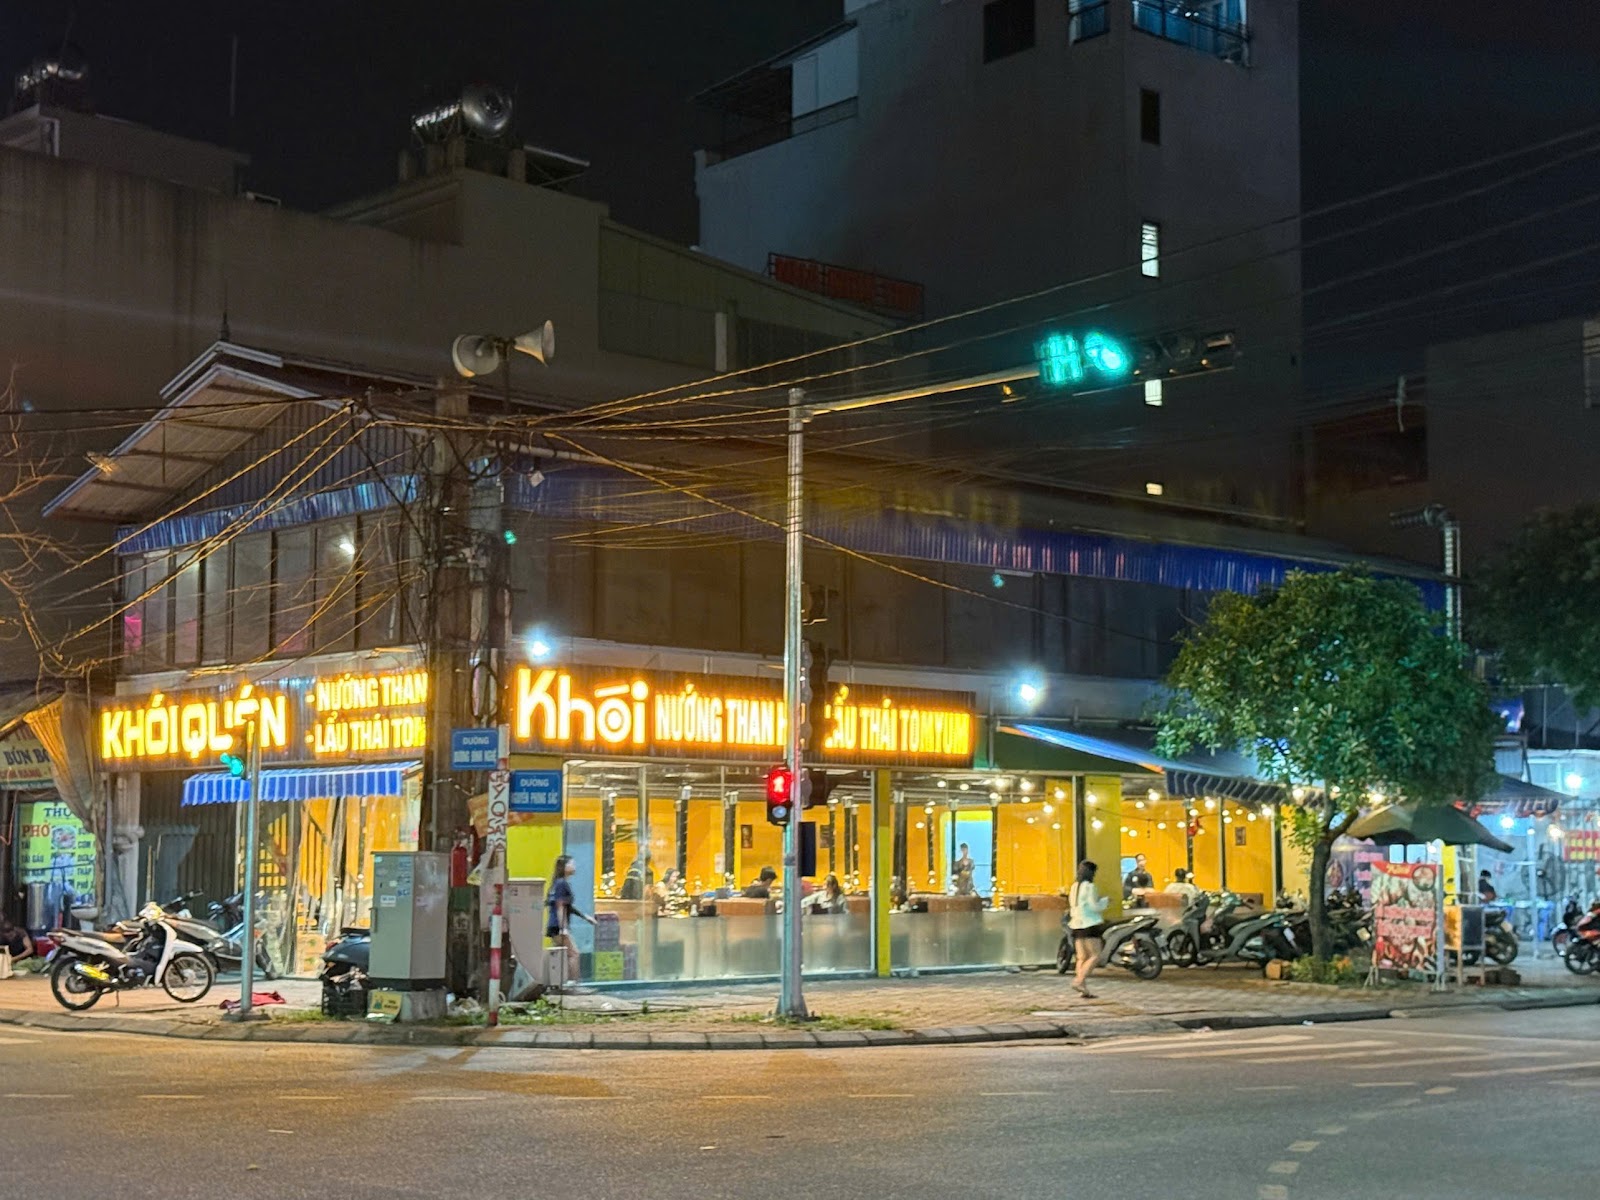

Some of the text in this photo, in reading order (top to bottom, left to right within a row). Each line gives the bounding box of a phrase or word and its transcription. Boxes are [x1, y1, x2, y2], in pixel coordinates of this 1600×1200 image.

[316, 672, 428, 711] NƯỚNG THAN
[102, 694, 179, 758] KHÓI
[314, 711, 348, 752] LẨU
[350, 713, 389, 751] THÁI
[655, 683, 723, 743] NƯỚNG
[725, 698, 775, 745] THAN
[859, 698, 898, 750] THÁI
[900, 708, 970, 755] TOMYUM
[3, 746, 34, 765] BÚN
[21, 819, 51, 838] PHỞ
